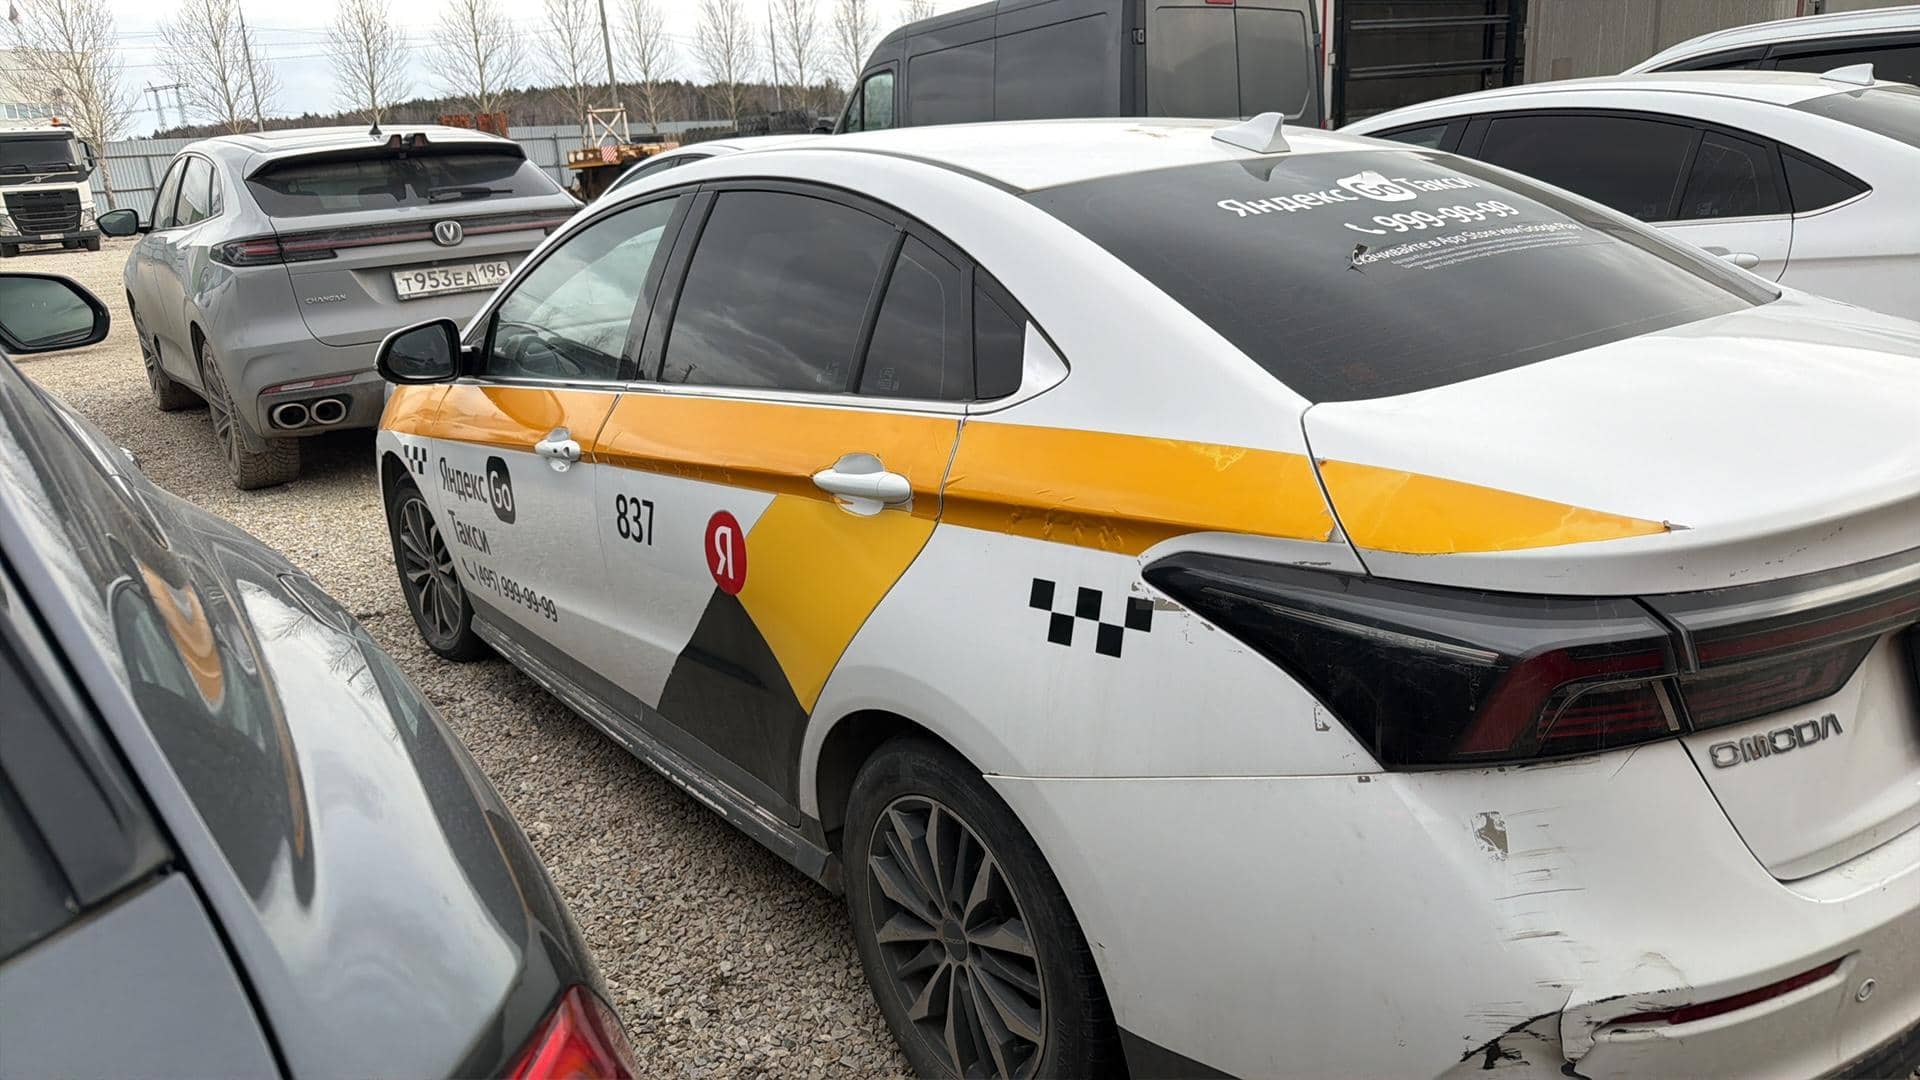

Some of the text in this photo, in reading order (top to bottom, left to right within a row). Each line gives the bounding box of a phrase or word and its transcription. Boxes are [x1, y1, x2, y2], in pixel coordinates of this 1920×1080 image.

[1217, 189, 1359, 218] Яндекс
[1391, 177, 1481, 192] Такси
[1372, 200, 1520, 233] 999-99-99
[478, 263, 508, 279] 196
[1352, 242, 1432, 265] Скачивайте
[1436, 233, 1467, 246] App
[439, 457, 488, 504] Яндекс
[447, 509, 492, 556] Такси
[616, 494, 654, 546] 837
[715, 525, 734, 580] Я
[473, 560, 559, 623] (495) 999-99-99
[1709, 712, 1844, 769] OMODA
